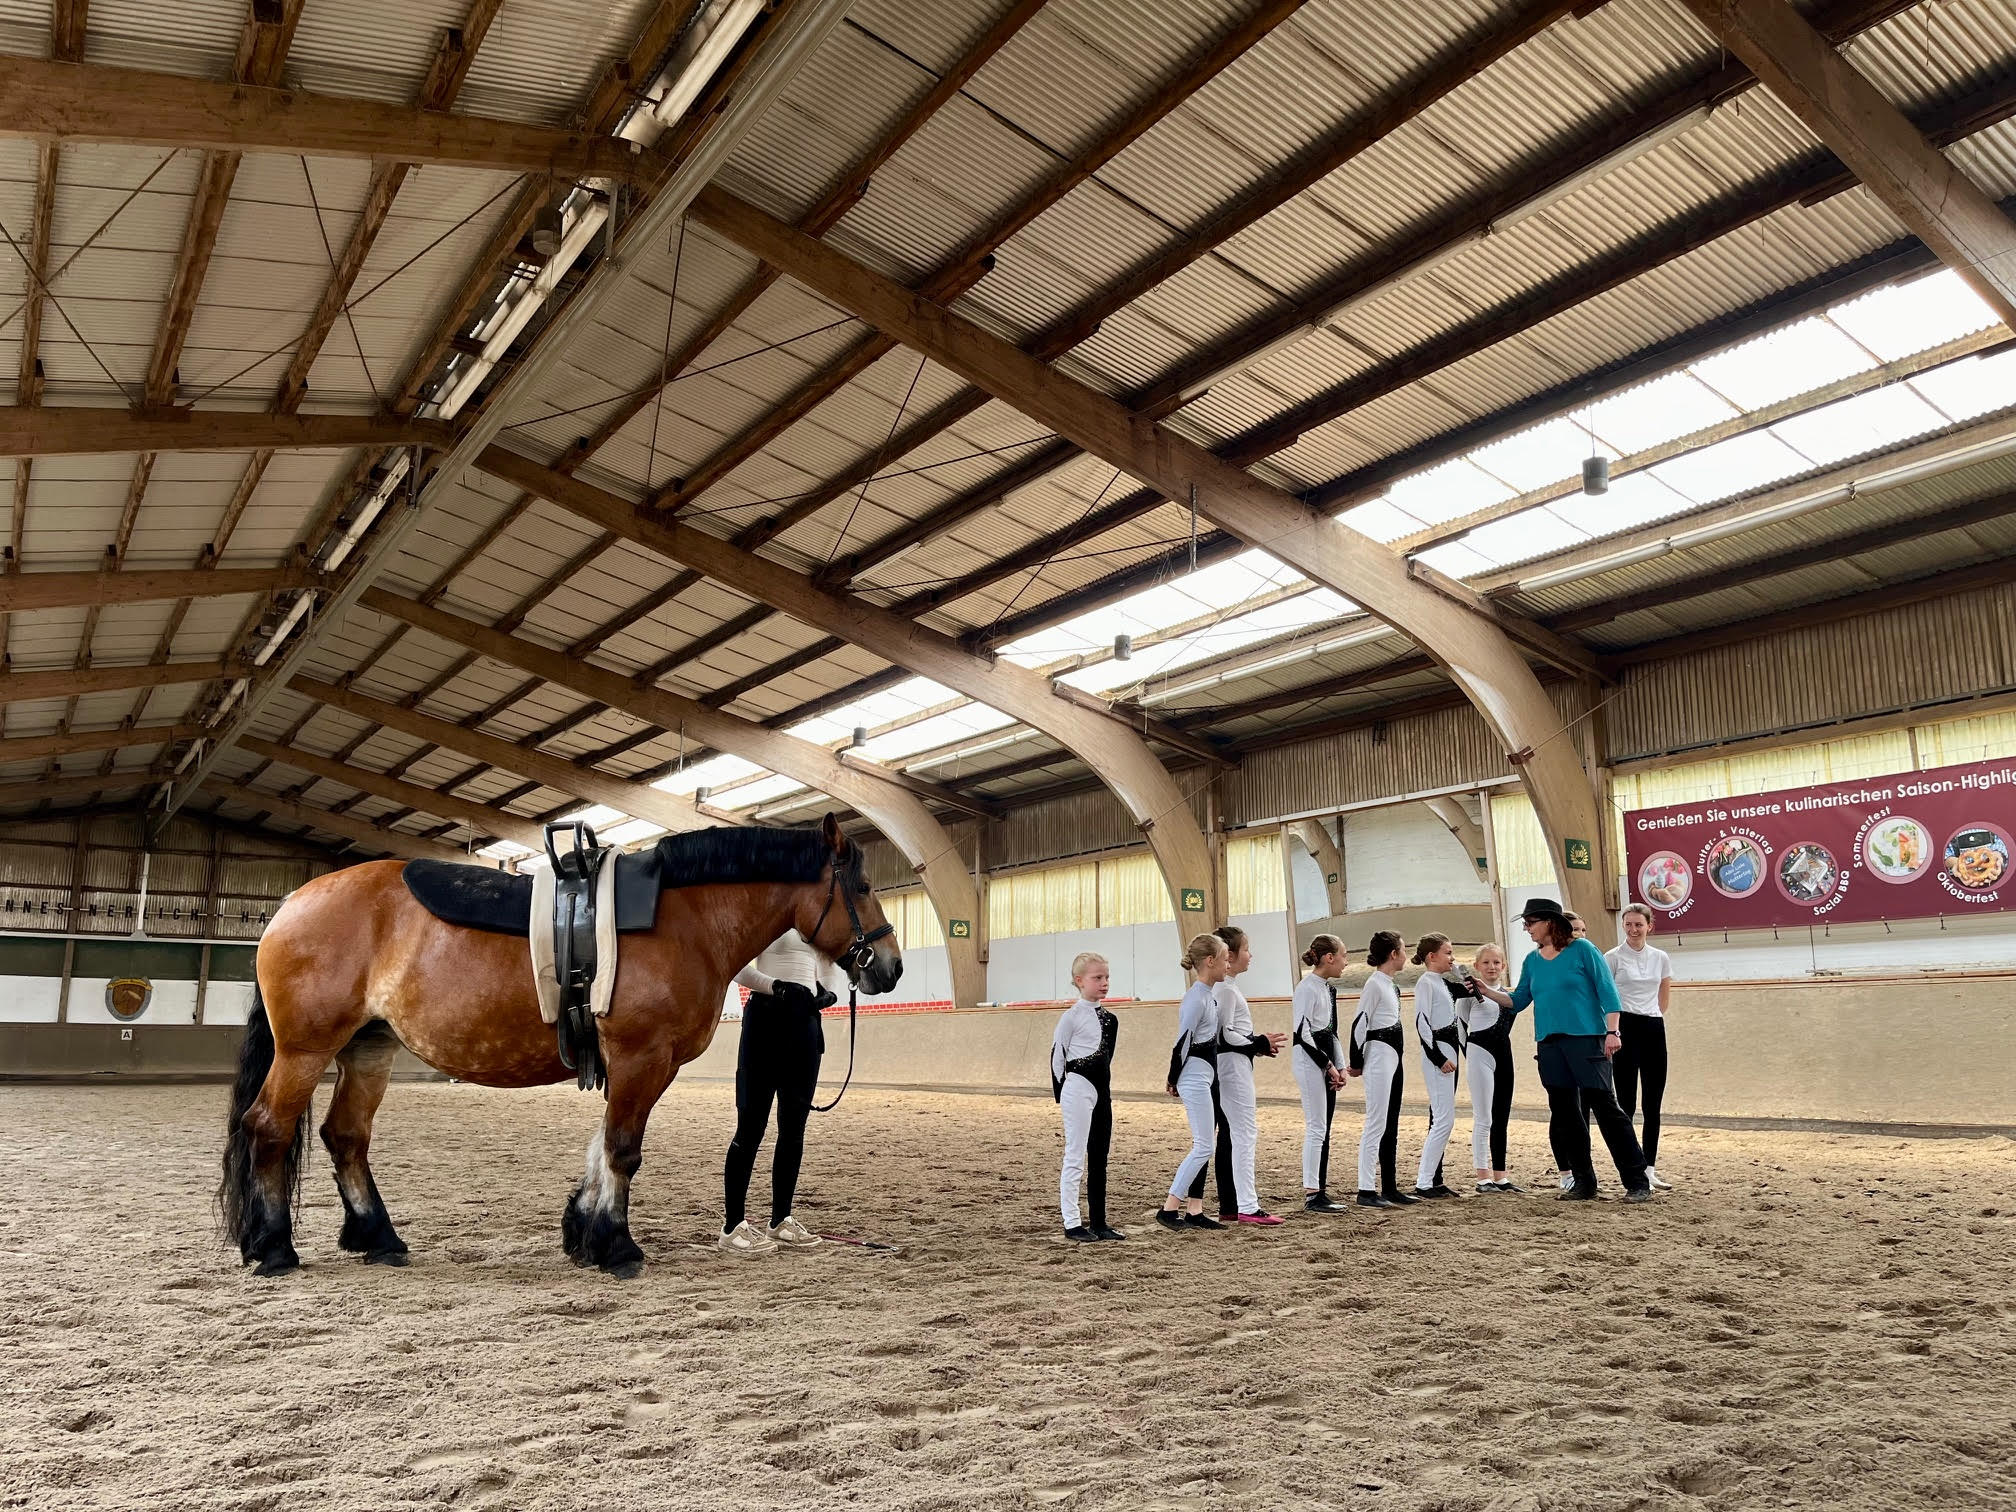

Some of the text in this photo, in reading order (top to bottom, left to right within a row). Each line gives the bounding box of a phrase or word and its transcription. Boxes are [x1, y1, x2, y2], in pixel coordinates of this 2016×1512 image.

[1637, 813, 1703, 831] Genießen
[1706, 809, 1728, 823] Sie
[1731, 802, 1781, 819] unsere
[1785, 787, 1892, 813] kulinarischen
[1697, 826, 1774, 874] Mutter- & Vatertag
[1853, 806, 1891, 868] Sommerfest
[1813, 870, 1850, 916] Social BBQ
[1937, 872, 1999, 903] Oktoberfest
[89, 904, 199, 920] NERLICH
[1668, 897, 1695, 919] Ostern
[122, 1031, 131, 1039] A
